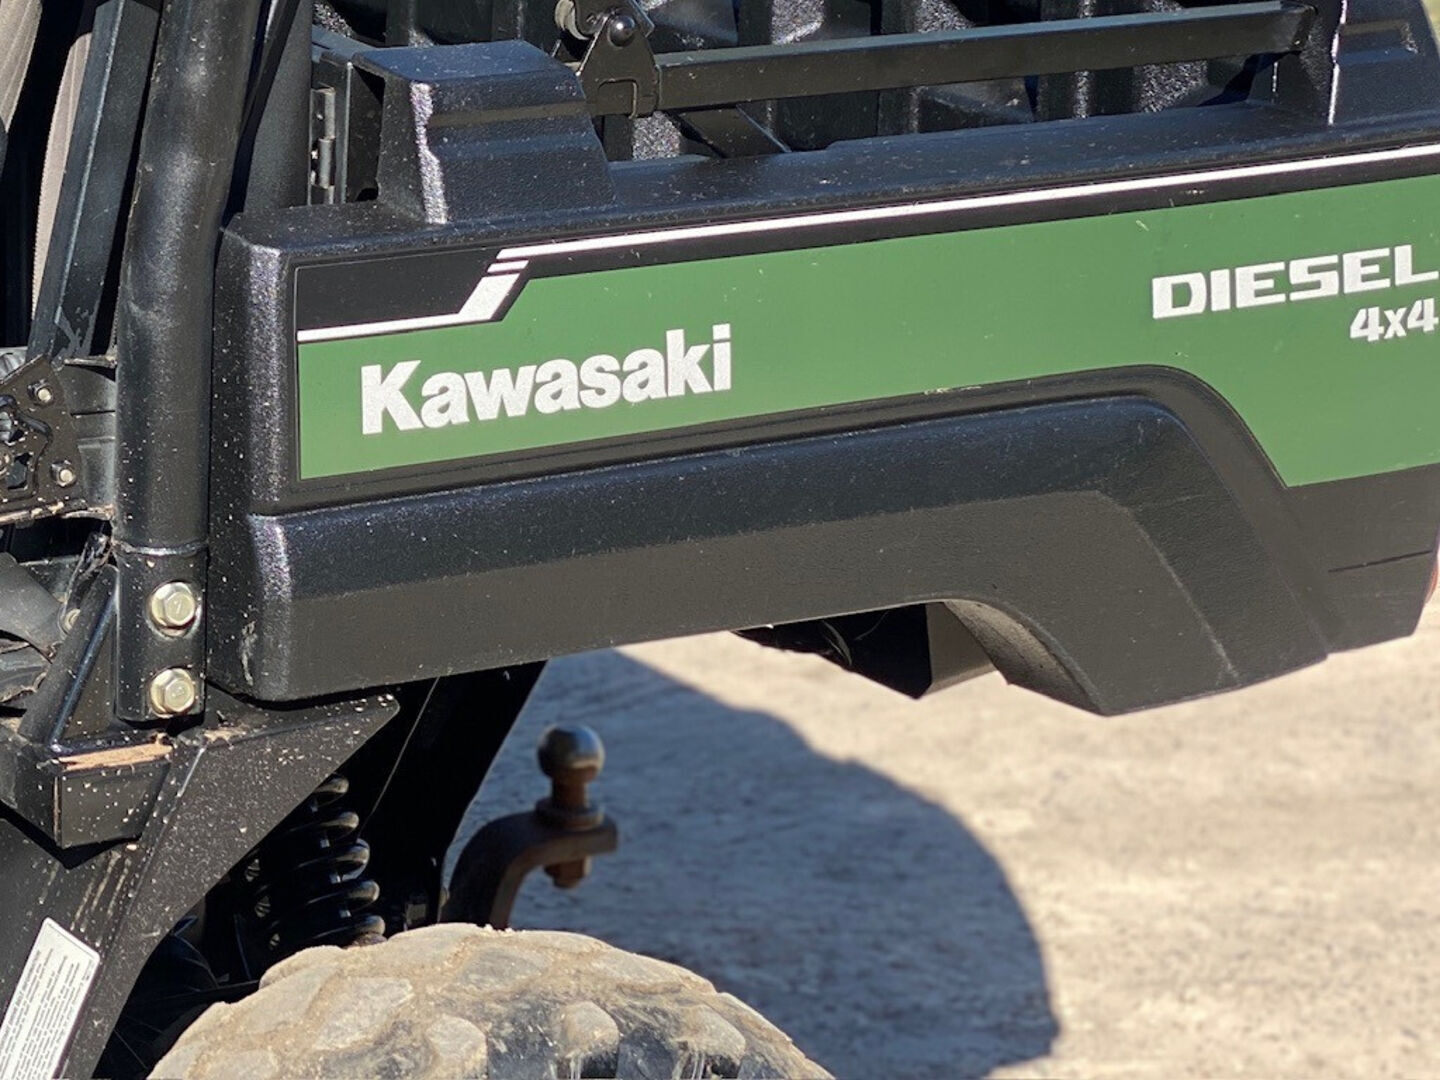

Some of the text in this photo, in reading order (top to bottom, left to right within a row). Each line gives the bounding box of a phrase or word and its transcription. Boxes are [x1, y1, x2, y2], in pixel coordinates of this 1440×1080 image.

[1151, 244, 1439, 320] DIESEL
[1349, 297, 1439, 342] 4x4
[361, 323, 731, 435] Kawasaki
